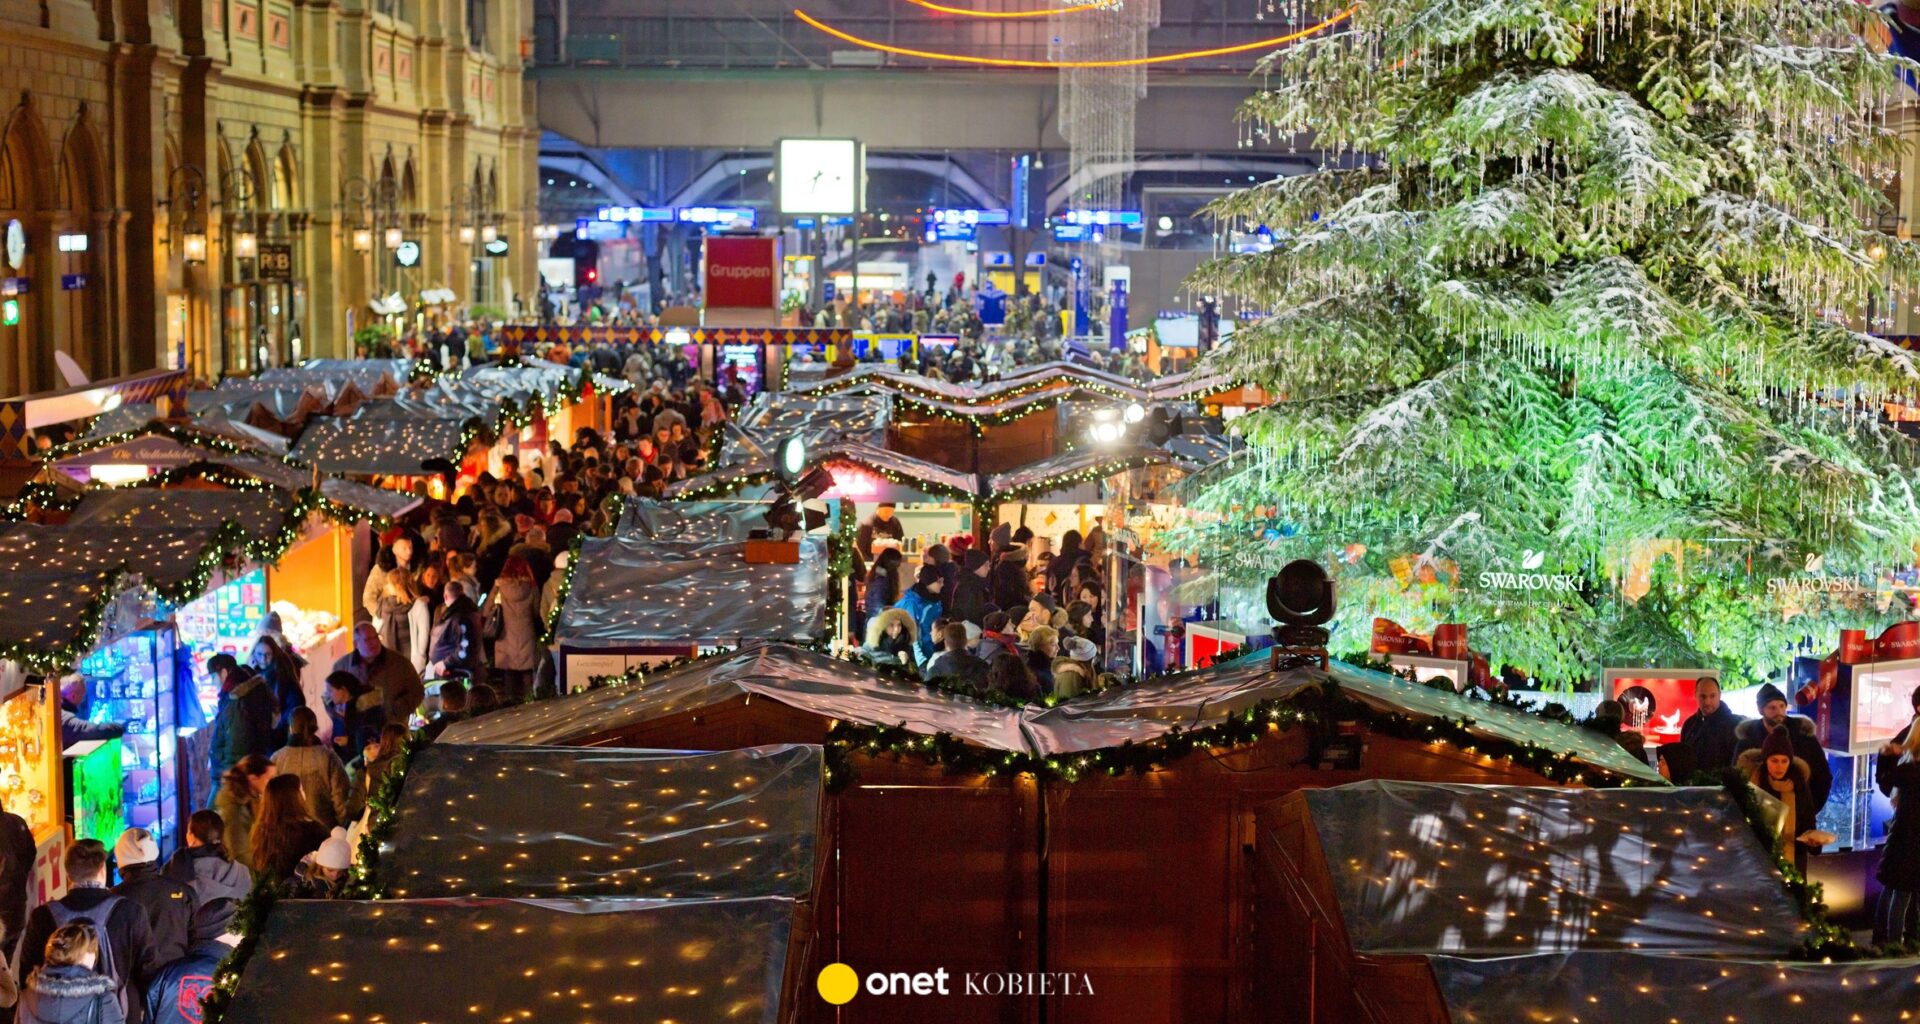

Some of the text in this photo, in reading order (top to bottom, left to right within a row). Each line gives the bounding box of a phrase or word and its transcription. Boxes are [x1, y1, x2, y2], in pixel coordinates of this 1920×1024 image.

[710, 264, 770, 279] Gruppen
[1479, 572, 1584, 592] SWAROVSKI
[1766, 576, 1858, 593] SWAROVSKI
